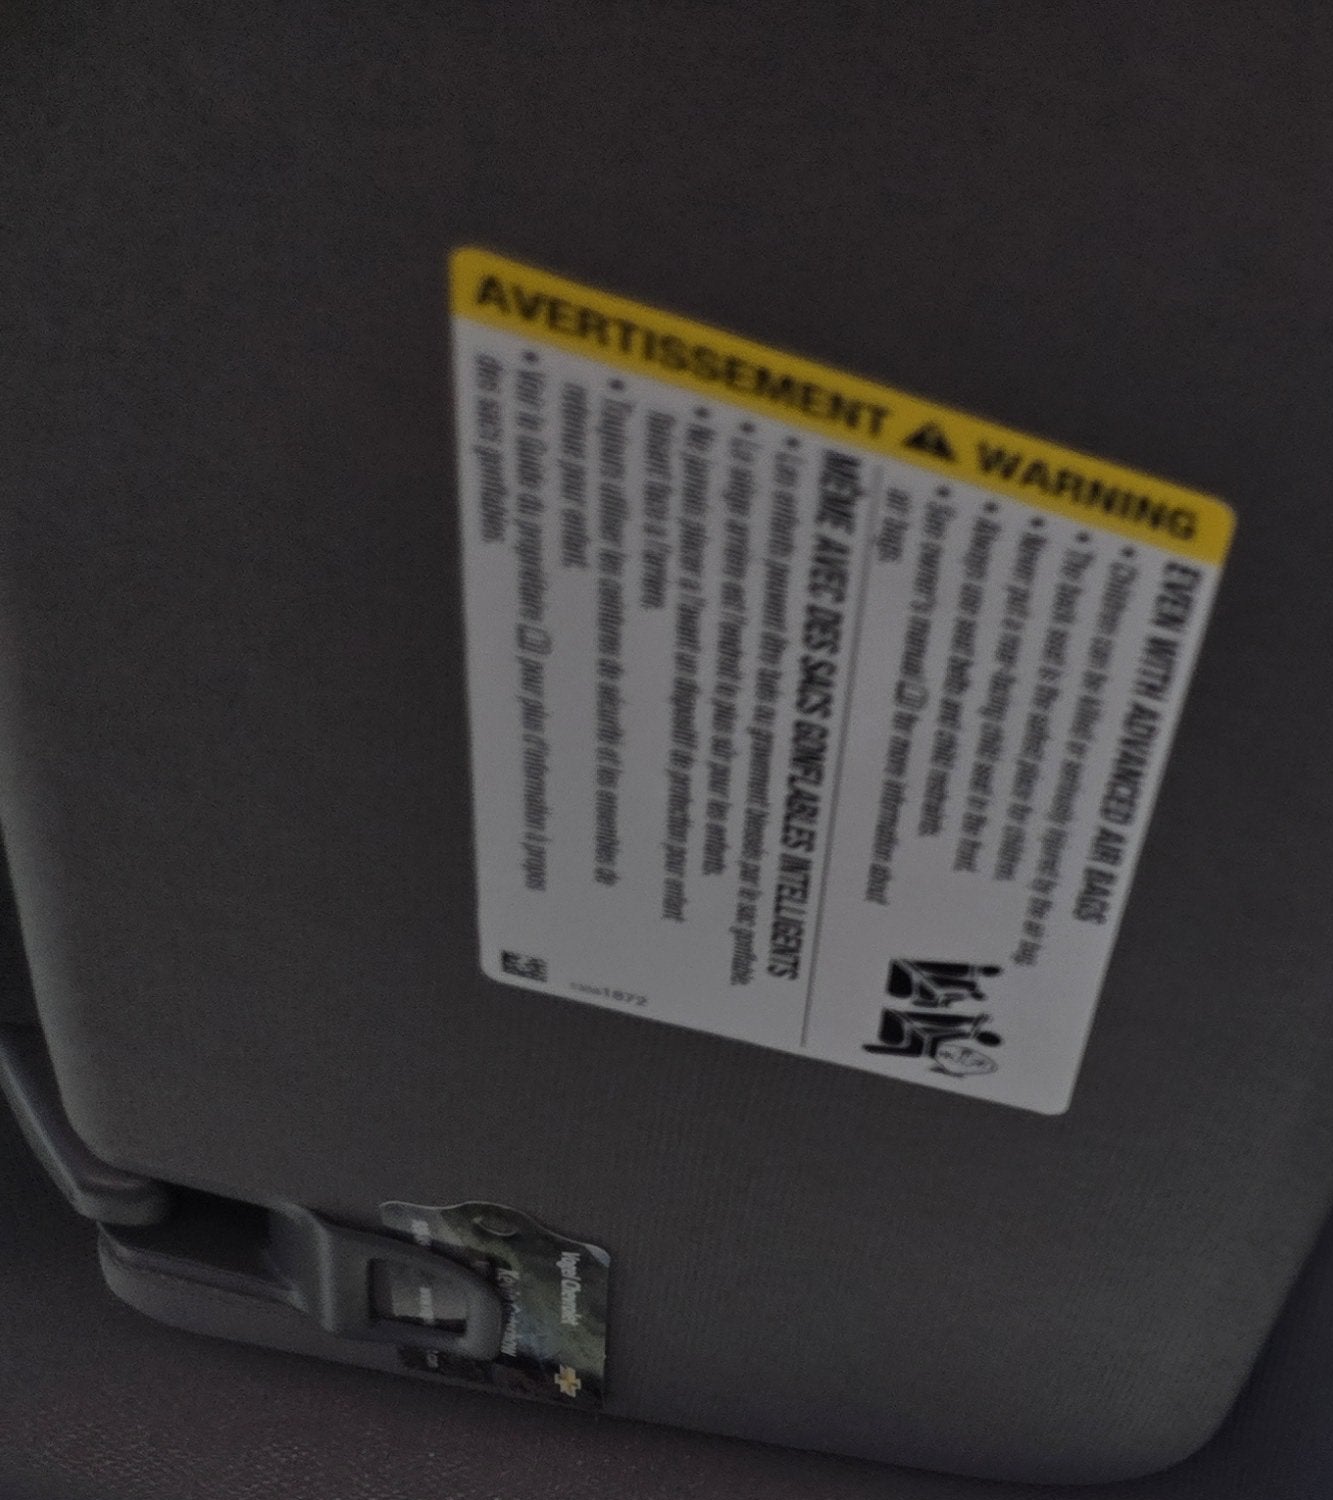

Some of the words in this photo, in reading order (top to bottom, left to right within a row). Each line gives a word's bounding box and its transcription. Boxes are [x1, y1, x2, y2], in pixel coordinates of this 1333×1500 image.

[474, 269, 889, 441] AVERTISSEMENT
[972, 440, 1201, 543] WARNING
[475, 351, 502, 398] des
[514, 364, 544, 414] Voir
[476, 393, 503, 446] sacs
[473, 441, 505, 548] gonflables.
[515, 432, 544, 493] Guide
[815, 447, 863, 535] MÊME
[874, 513, 907, 568] bags.
[921, 498, 951, 542] See
[512, 516, 545, 625] propriétaire
[807, 533, 852, 606] AVEC
[909, 537, 945, 617] owner's
[1149, 559, 1201, 634] EVEN
[802, 601, 844, 657] DES
[899, 613, 933, 684] manual
[515, 655, 546, 697] pour
[795, 653, 838, 720] SACS
[1132, 633, 1182, 703] WITH
[515, 694, 546, 734] plus
[520, 731, 546, 833] d'information
[781, 718, 830, 853] GONFLABLES
[885, 735, 913, 779] more
[1099, 701, 1163, 829] ADVANCED
[872, 777, 907, 865] information
[1089, 826, 1130, 868] AIR
[518, 841, 547, 893] propos
[866, 862, 893, 907] about
[1074, 867, 1119, 927] BAGS
[767, 851, 814, 982] INTELLIGENTS
[560, 1279, 581, 1326] Chevrolet
